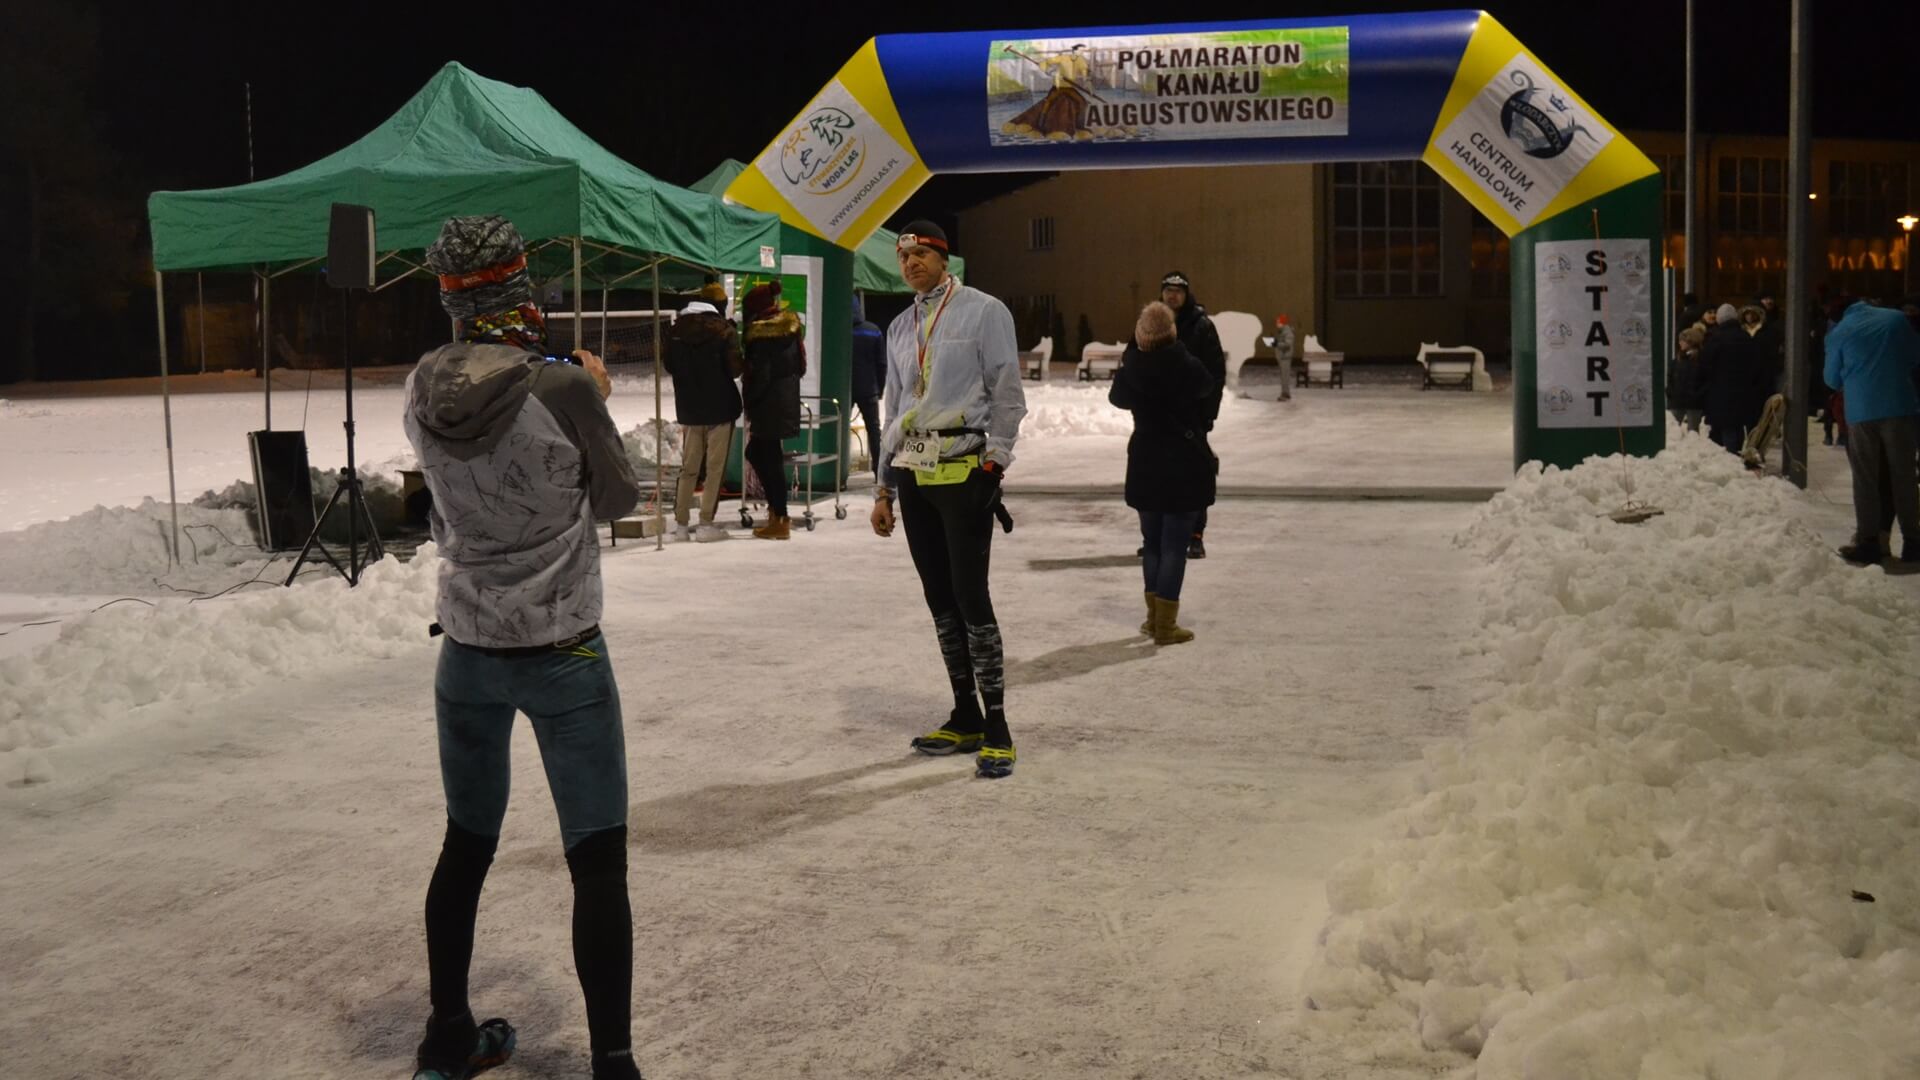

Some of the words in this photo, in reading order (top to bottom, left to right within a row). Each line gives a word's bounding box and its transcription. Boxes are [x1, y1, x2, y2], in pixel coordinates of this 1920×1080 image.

[1118, 44, 1300, 70] PÓŁMARATON
[1156, 71, 1261, 97] KANAŁU
[1085, 97, 1334, 127] AUGUSTOWSKIEGO
[822, 166, 846, 189] WODA
[845, 150, 859, 168] LAS
[1450, 141, 1526, 212] HANDLOWE
[1469, 132, 1534, 192] CENTRUM
[829, 159, 900, 227] WWW.WODALAS.PL
[1585, 250, 1610, 417] START
